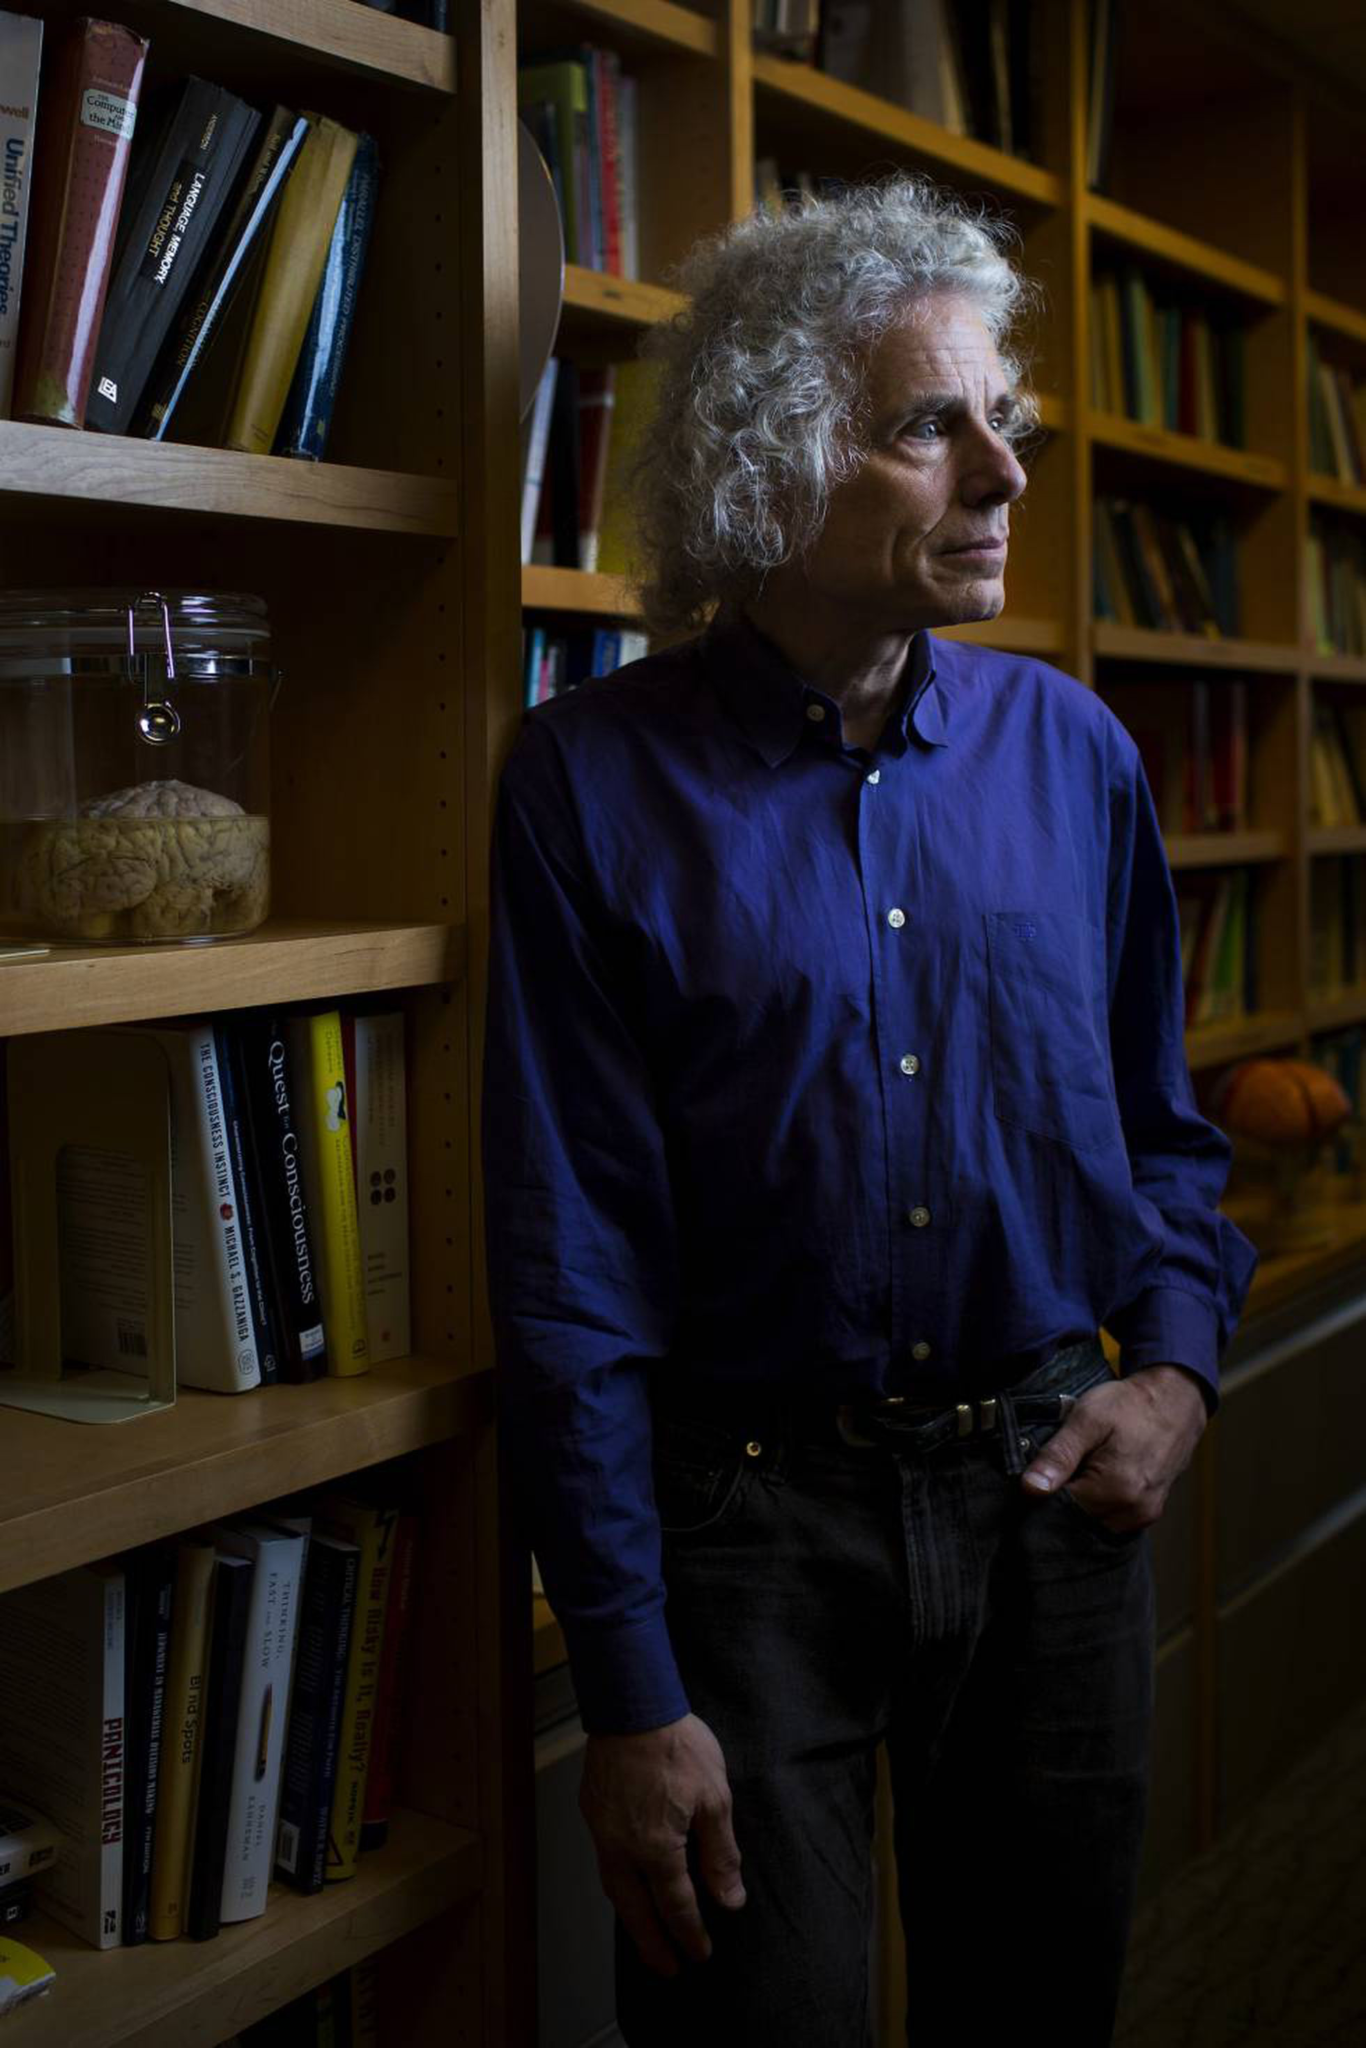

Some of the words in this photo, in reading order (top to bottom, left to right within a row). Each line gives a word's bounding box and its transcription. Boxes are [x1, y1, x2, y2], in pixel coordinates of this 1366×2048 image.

[3, 138, 24, 217] Unified
[172, 171, 207, 235] LANGUAGE,
[145, 202, 177, 257] THOUGHT
[0, 221, 18, 315] Theories
[152, 232, 182, 283] MEMORY,
[340, 234, 362, 314] DISTRIBUTED
[199, 1044, 211, 1062] THE
[201, 1065, 223, 1149] CONSCIOUSNESS
[213, 1151, 230, 1198] INSTINCT
[264, 1039, 292, 1114] Quest
[279, 1131, 318, 1304] Consciousness
[223, 1226, 240, 1269] MICHAEL
[229, 1272, 242, 1283] S.
[231, 1285, 250, 1341] GAZZANIGA
[265, 1572, 280, 1604] FAST
[340, 1557, 357, 1605] CRITICAL
[369, 1566, 386, 1600] How
[258, 1629, 273, 1668] SLOW
[361, 1607, 382, 1653] Risky
[360, 1660, 376, 1676] Is
[179, 1719, 197, 1763] Spots
[347, 1707, 373, 1772] Really?
[100, 1717, 124, 1844] PANICOLOGY
